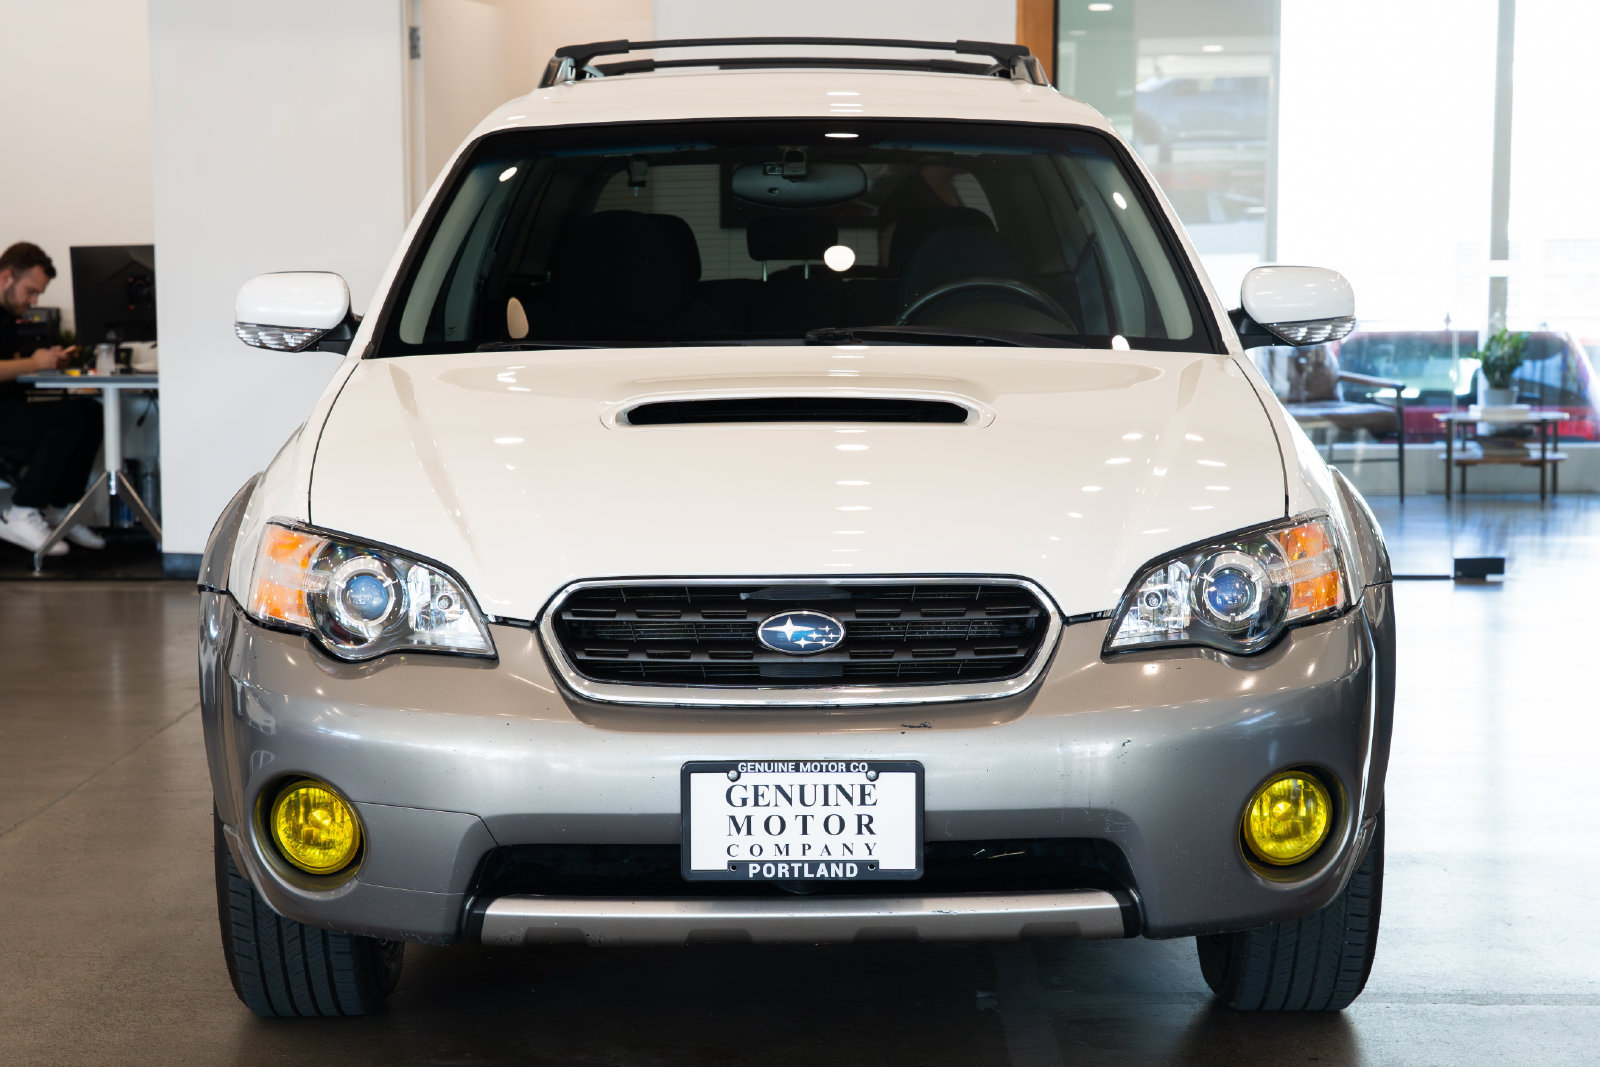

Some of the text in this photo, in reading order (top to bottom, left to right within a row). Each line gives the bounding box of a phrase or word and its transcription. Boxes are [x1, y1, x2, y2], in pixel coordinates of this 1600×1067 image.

[737, 762, 869, 773] GENUINE MOTOR CO
[725, 783, 878, 808] GENUINE
[726, 813, 877, 837] MOTOR
[726, 842, 878, 858] COMPANY
[748, 862, 859, 878] PORTLAND
